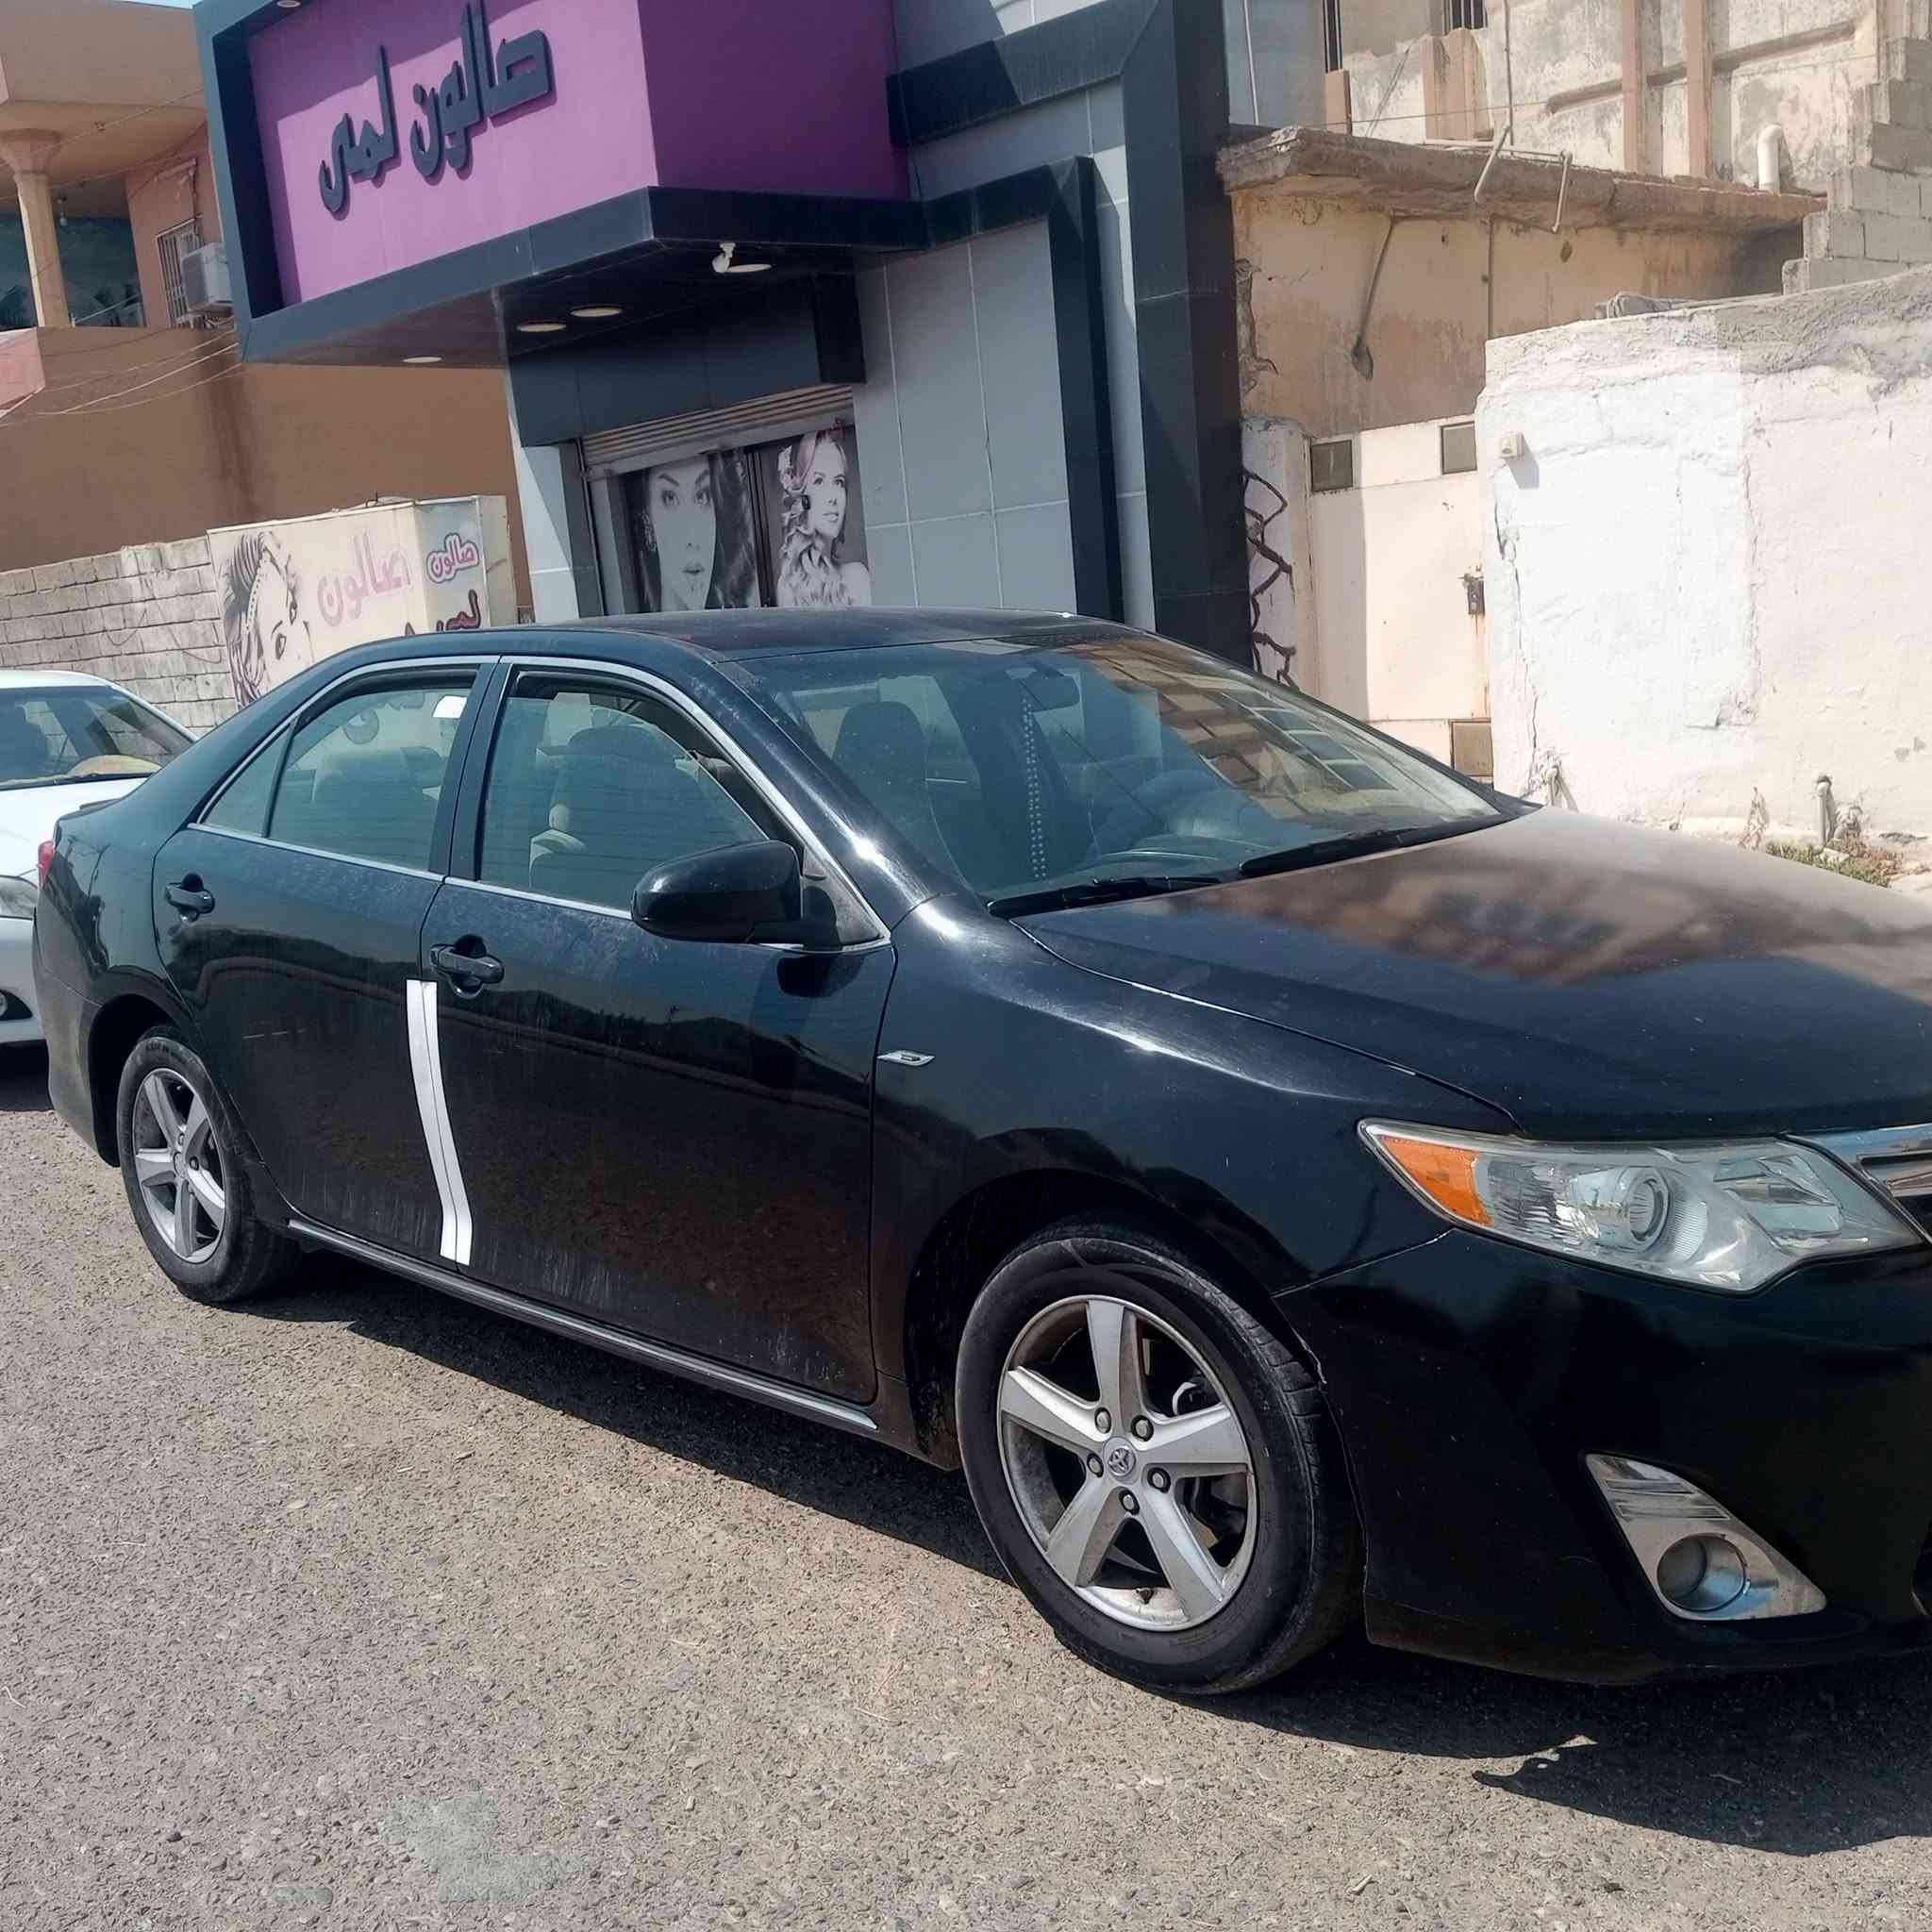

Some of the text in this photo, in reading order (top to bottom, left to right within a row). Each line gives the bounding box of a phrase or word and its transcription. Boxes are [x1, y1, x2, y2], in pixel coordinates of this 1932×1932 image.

[319, 0, 551, 213] صالون لمى
[427, 534, 478, 582] صالون
